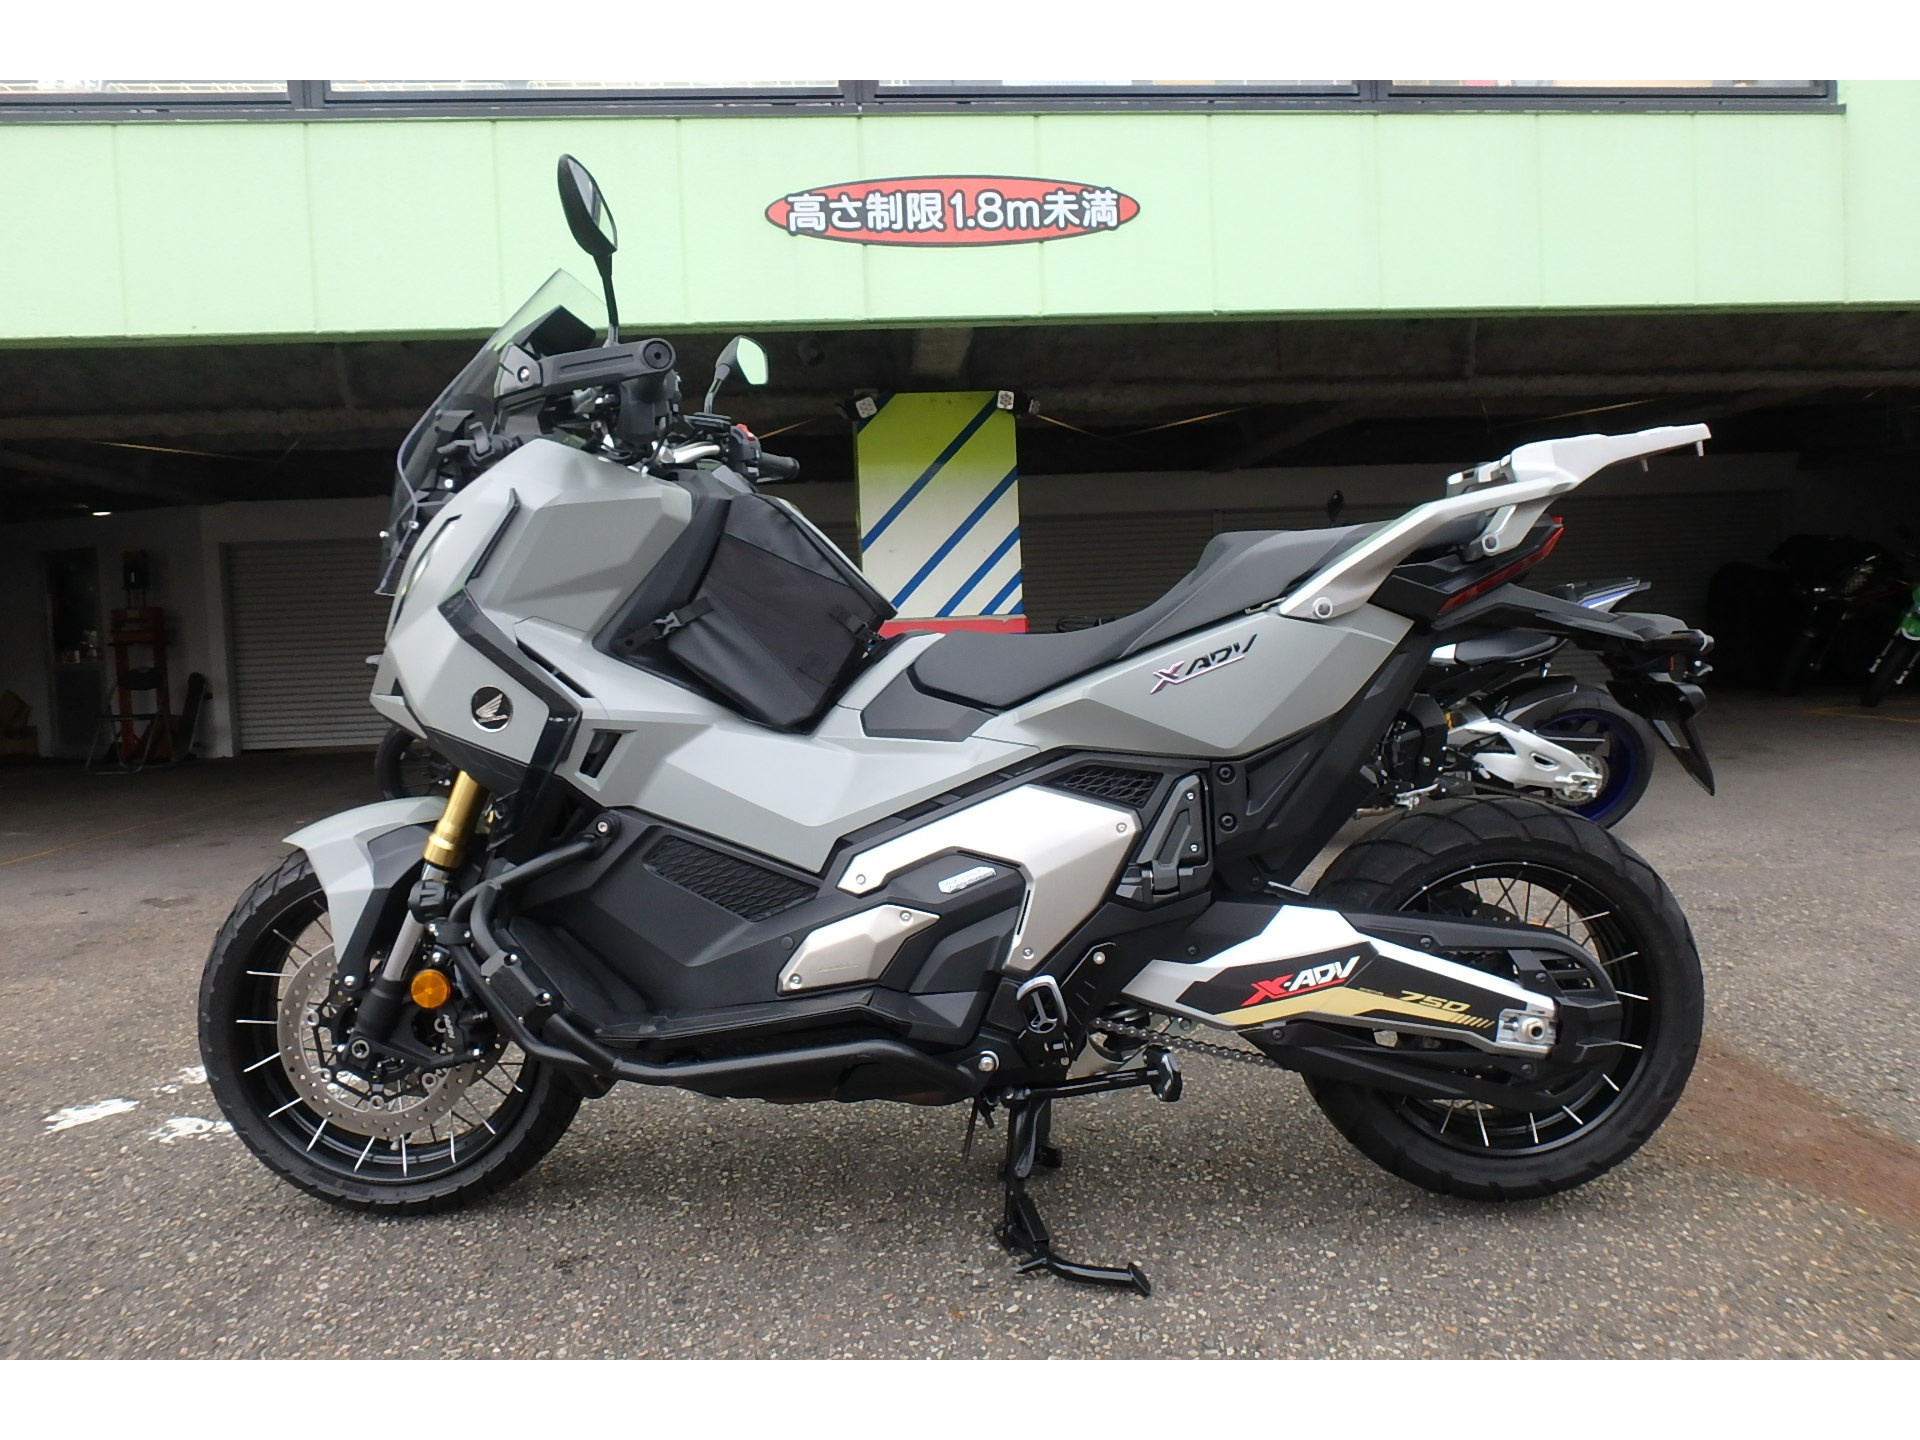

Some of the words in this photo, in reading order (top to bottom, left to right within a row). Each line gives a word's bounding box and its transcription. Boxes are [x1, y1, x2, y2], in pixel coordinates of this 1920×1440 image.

[787, 189, 1118, 232] 高さ制限1.8m未満
[1240, 955, 1361, 1007] X-ADV
[1400, 988, 1471, 1013] 750
